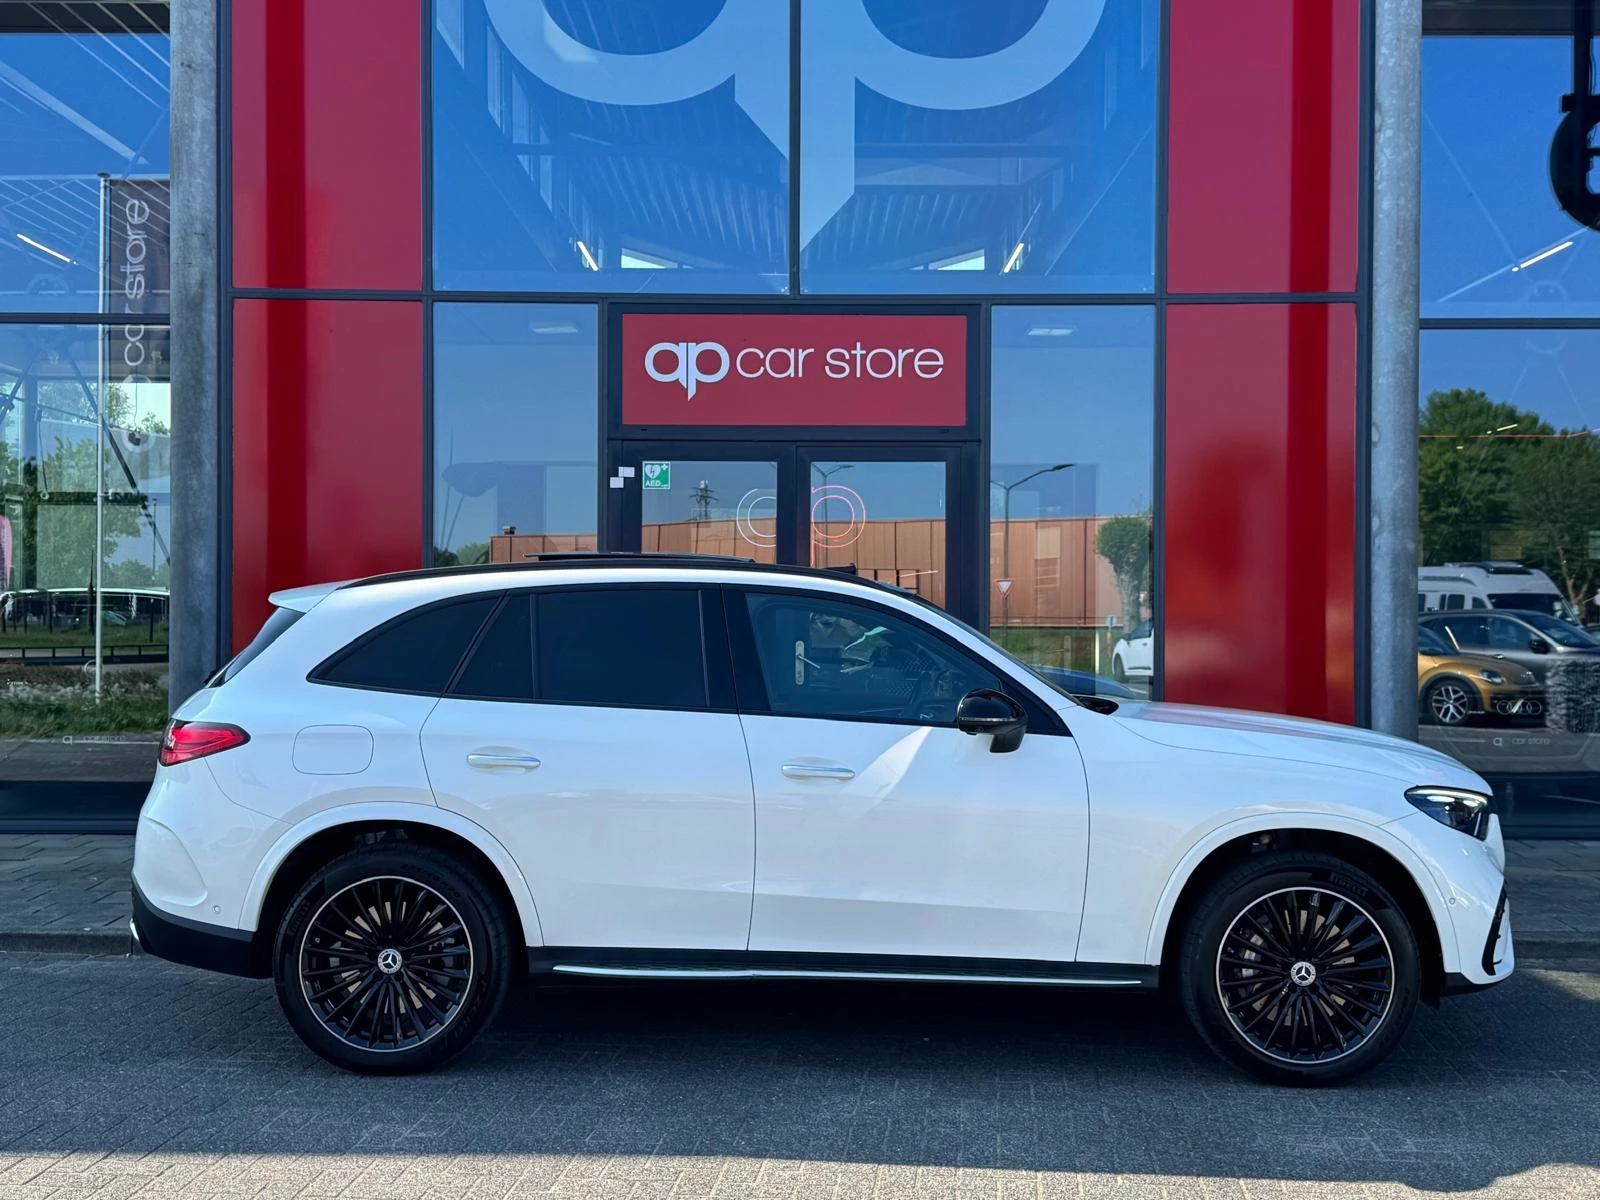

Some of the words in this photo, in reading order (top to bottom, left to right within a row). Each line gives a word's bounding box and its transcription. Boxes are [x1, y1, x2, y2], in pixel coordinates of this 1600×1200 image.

[120, 198, 150, 299] store
[644, 341, 730, 402] ap
[736, 348, 815, 378] car
[825, 341, 945, 379] store
[645, 479, 661, 487] AED
